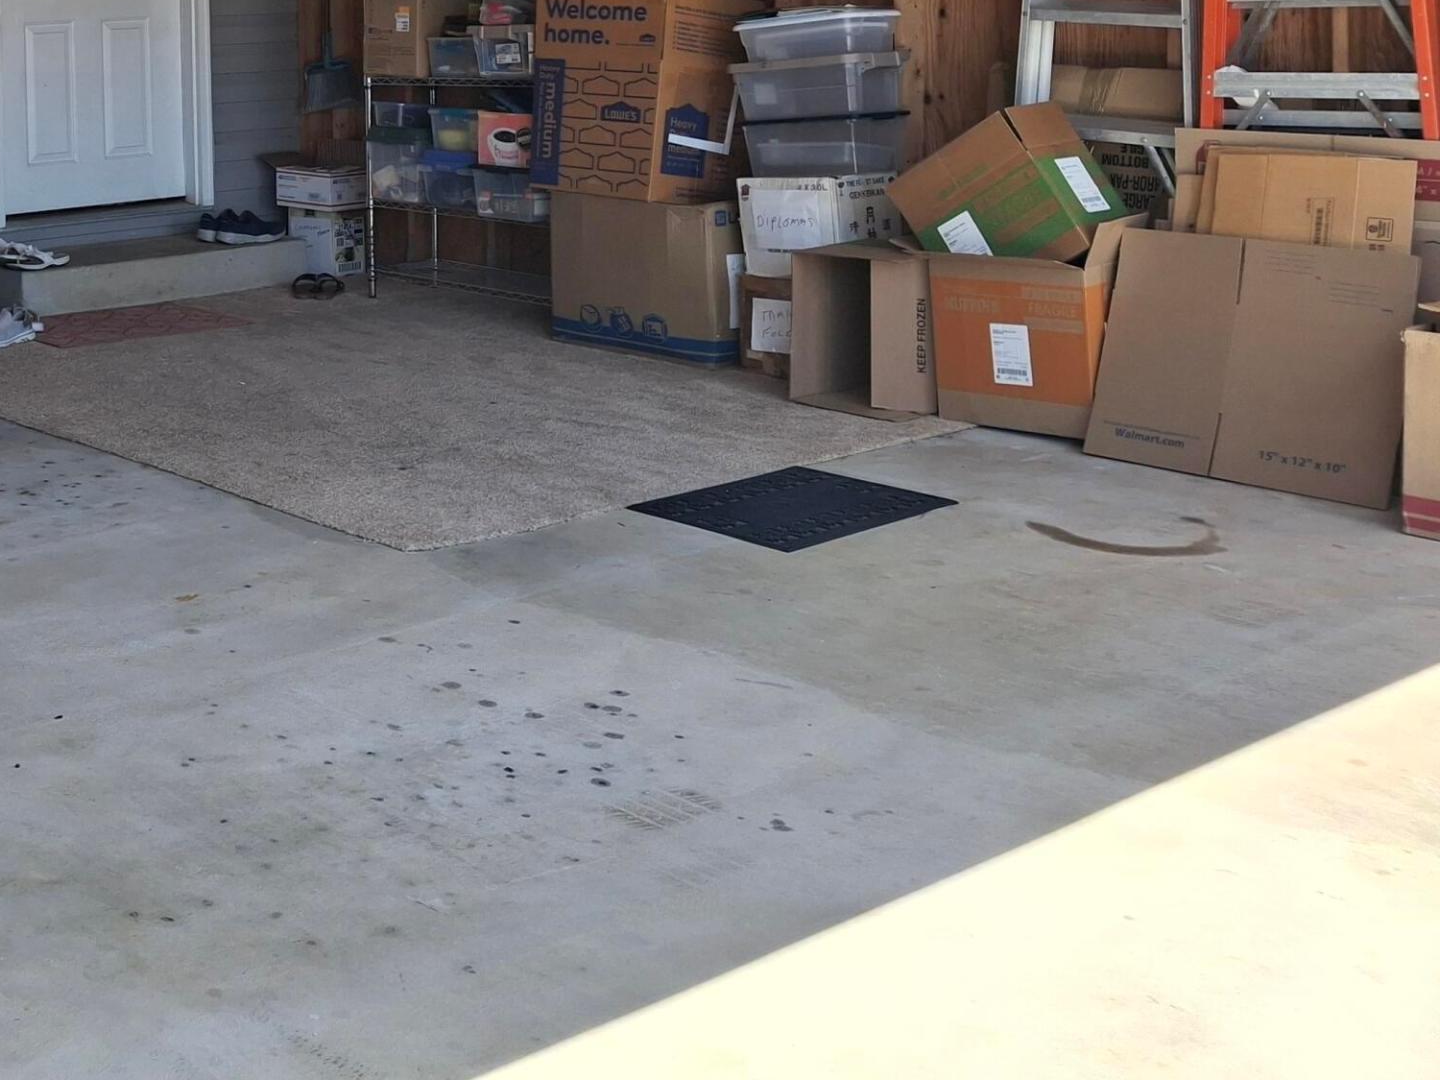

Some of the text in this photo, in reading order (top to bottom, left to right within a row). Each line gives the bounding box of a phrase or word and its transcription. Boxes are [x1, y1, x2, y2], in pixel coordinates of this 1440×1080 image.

[546, 0, 647, 21] Welcome
[544, 23, 610, 45] home.
[541, 81, 558, 159] medium
[916, 297, 927, 374] KEEP FROZEN
[1114, 427, 1185, 449] Walmart.com
